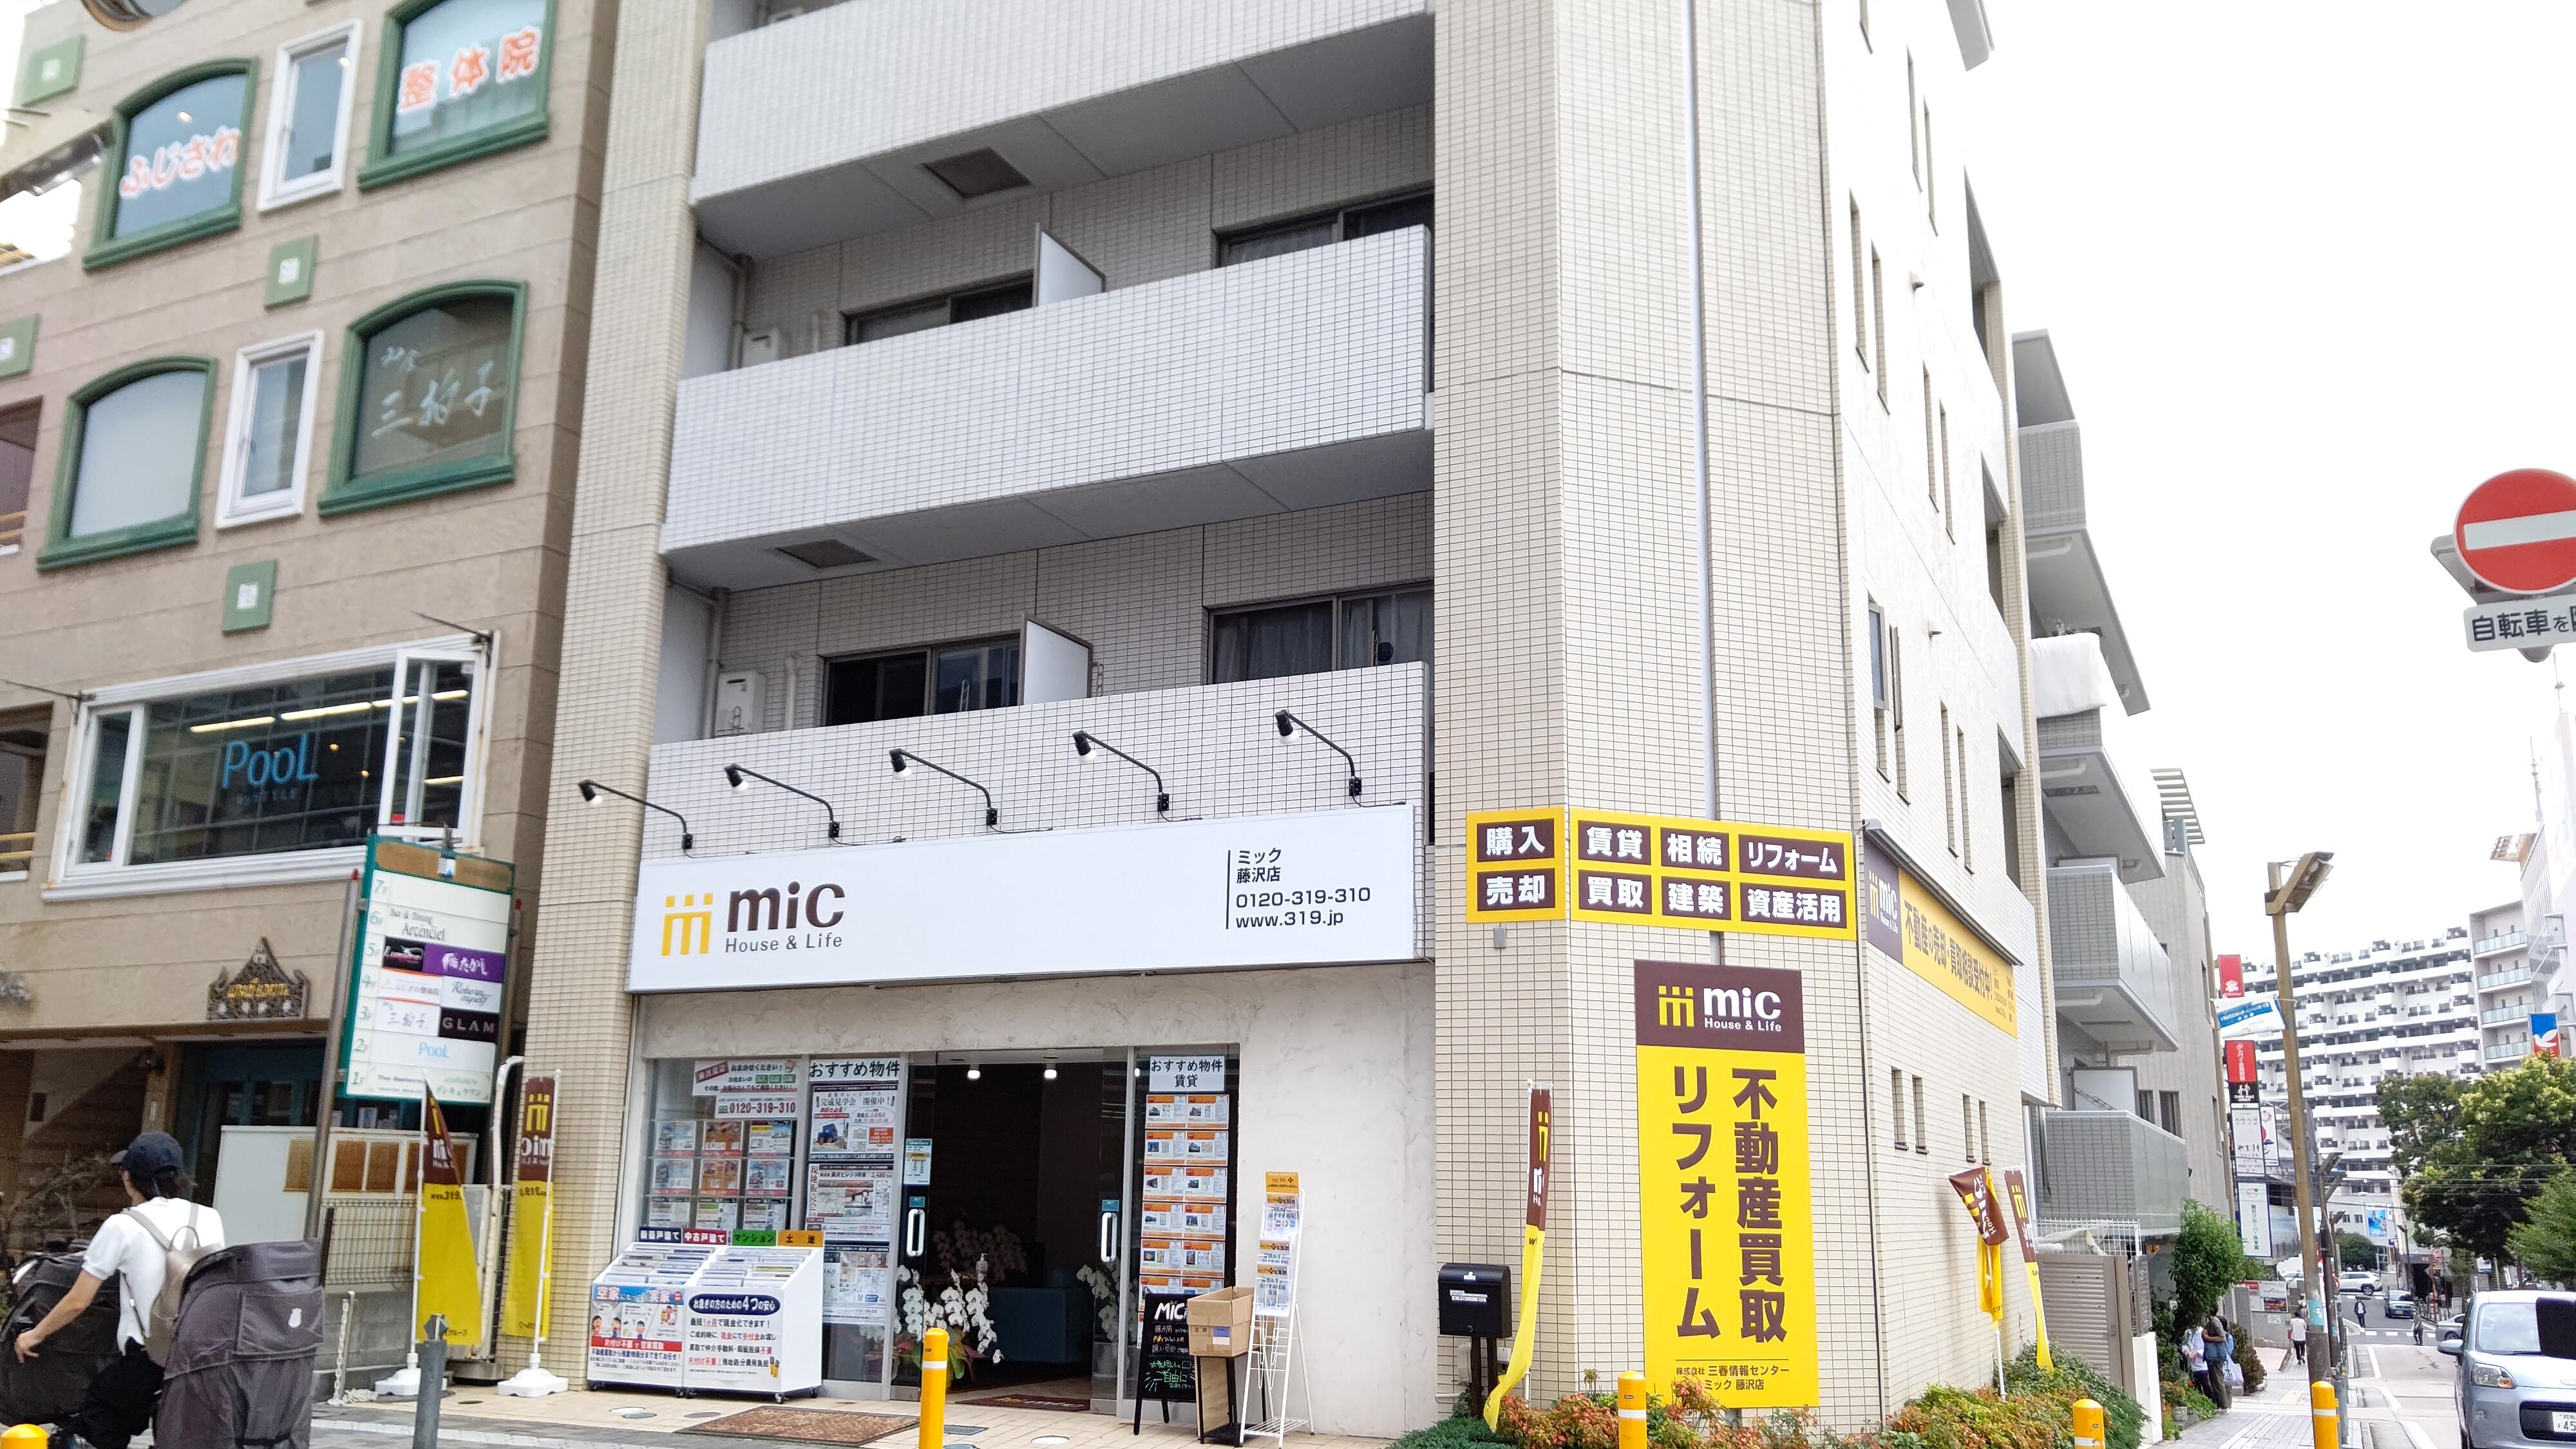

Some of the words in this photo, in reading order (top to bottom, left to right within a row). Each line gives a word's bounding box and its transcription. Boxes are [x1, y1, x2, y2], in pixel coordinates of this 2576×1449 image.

[397, 26, 541, 113] 整体院
[120, 126, 241, 198] ふじさわ
[1486, 826, 1545, 855] 購入
[1586, 826, 1643, 859] 賃貸
[1667, 833, 1722, 865] 相続
[1238, 848, 1282, 864] ミック
[1748, 842, 1838, 873] リフォーム
[1236, 866, 1282, 884] 藤沢店
[1236, 887, 1370, 908] 0120-319-310
[1486, 875, 1545, 905] 売却
[1587, 876, 1643, 908] 買取
[1668, 883, 1723, 914] 建築
[1879, 878, 1898, 920] mic
[727, 881, 845, 933] mic
[1236, 909, 1343, 928] www.319.jp
[1747, 889, 1841, 922] 資産活用
[725, 936, 779, 952] House
[786, 934, 797, 950] &
[806, 932, 843, 949] Life
[1703, 987, 1781, 1019] mic
[1705, 1017, 1741, 1030] House
[1745, 1019, 1754, 1030] &
[1757, 1020, 1782, 1032] Life
[809, 1061, 900, 1077] おすすめ物件
[1151, 1059, 1223, 1072] おすすめ物件
[1174, 1074, 1198, 1088] 賃貸
[729, 1101, 796, 1113] 0120-319-310
[1671, 1066, 1721, 1339] リフォーム
[1732, 1068, 1787, 1343] 不動産買取
[684, 1232, 725, 1244] 中古戸建て
[734, 1233, 774, 1243] マンション
[1704, 1379, 1732, 1390] ミック
[1736, 1379, 1765, 1390] 藤沢店
[1708, 1365, 1790, 1377] 三春情報センター
